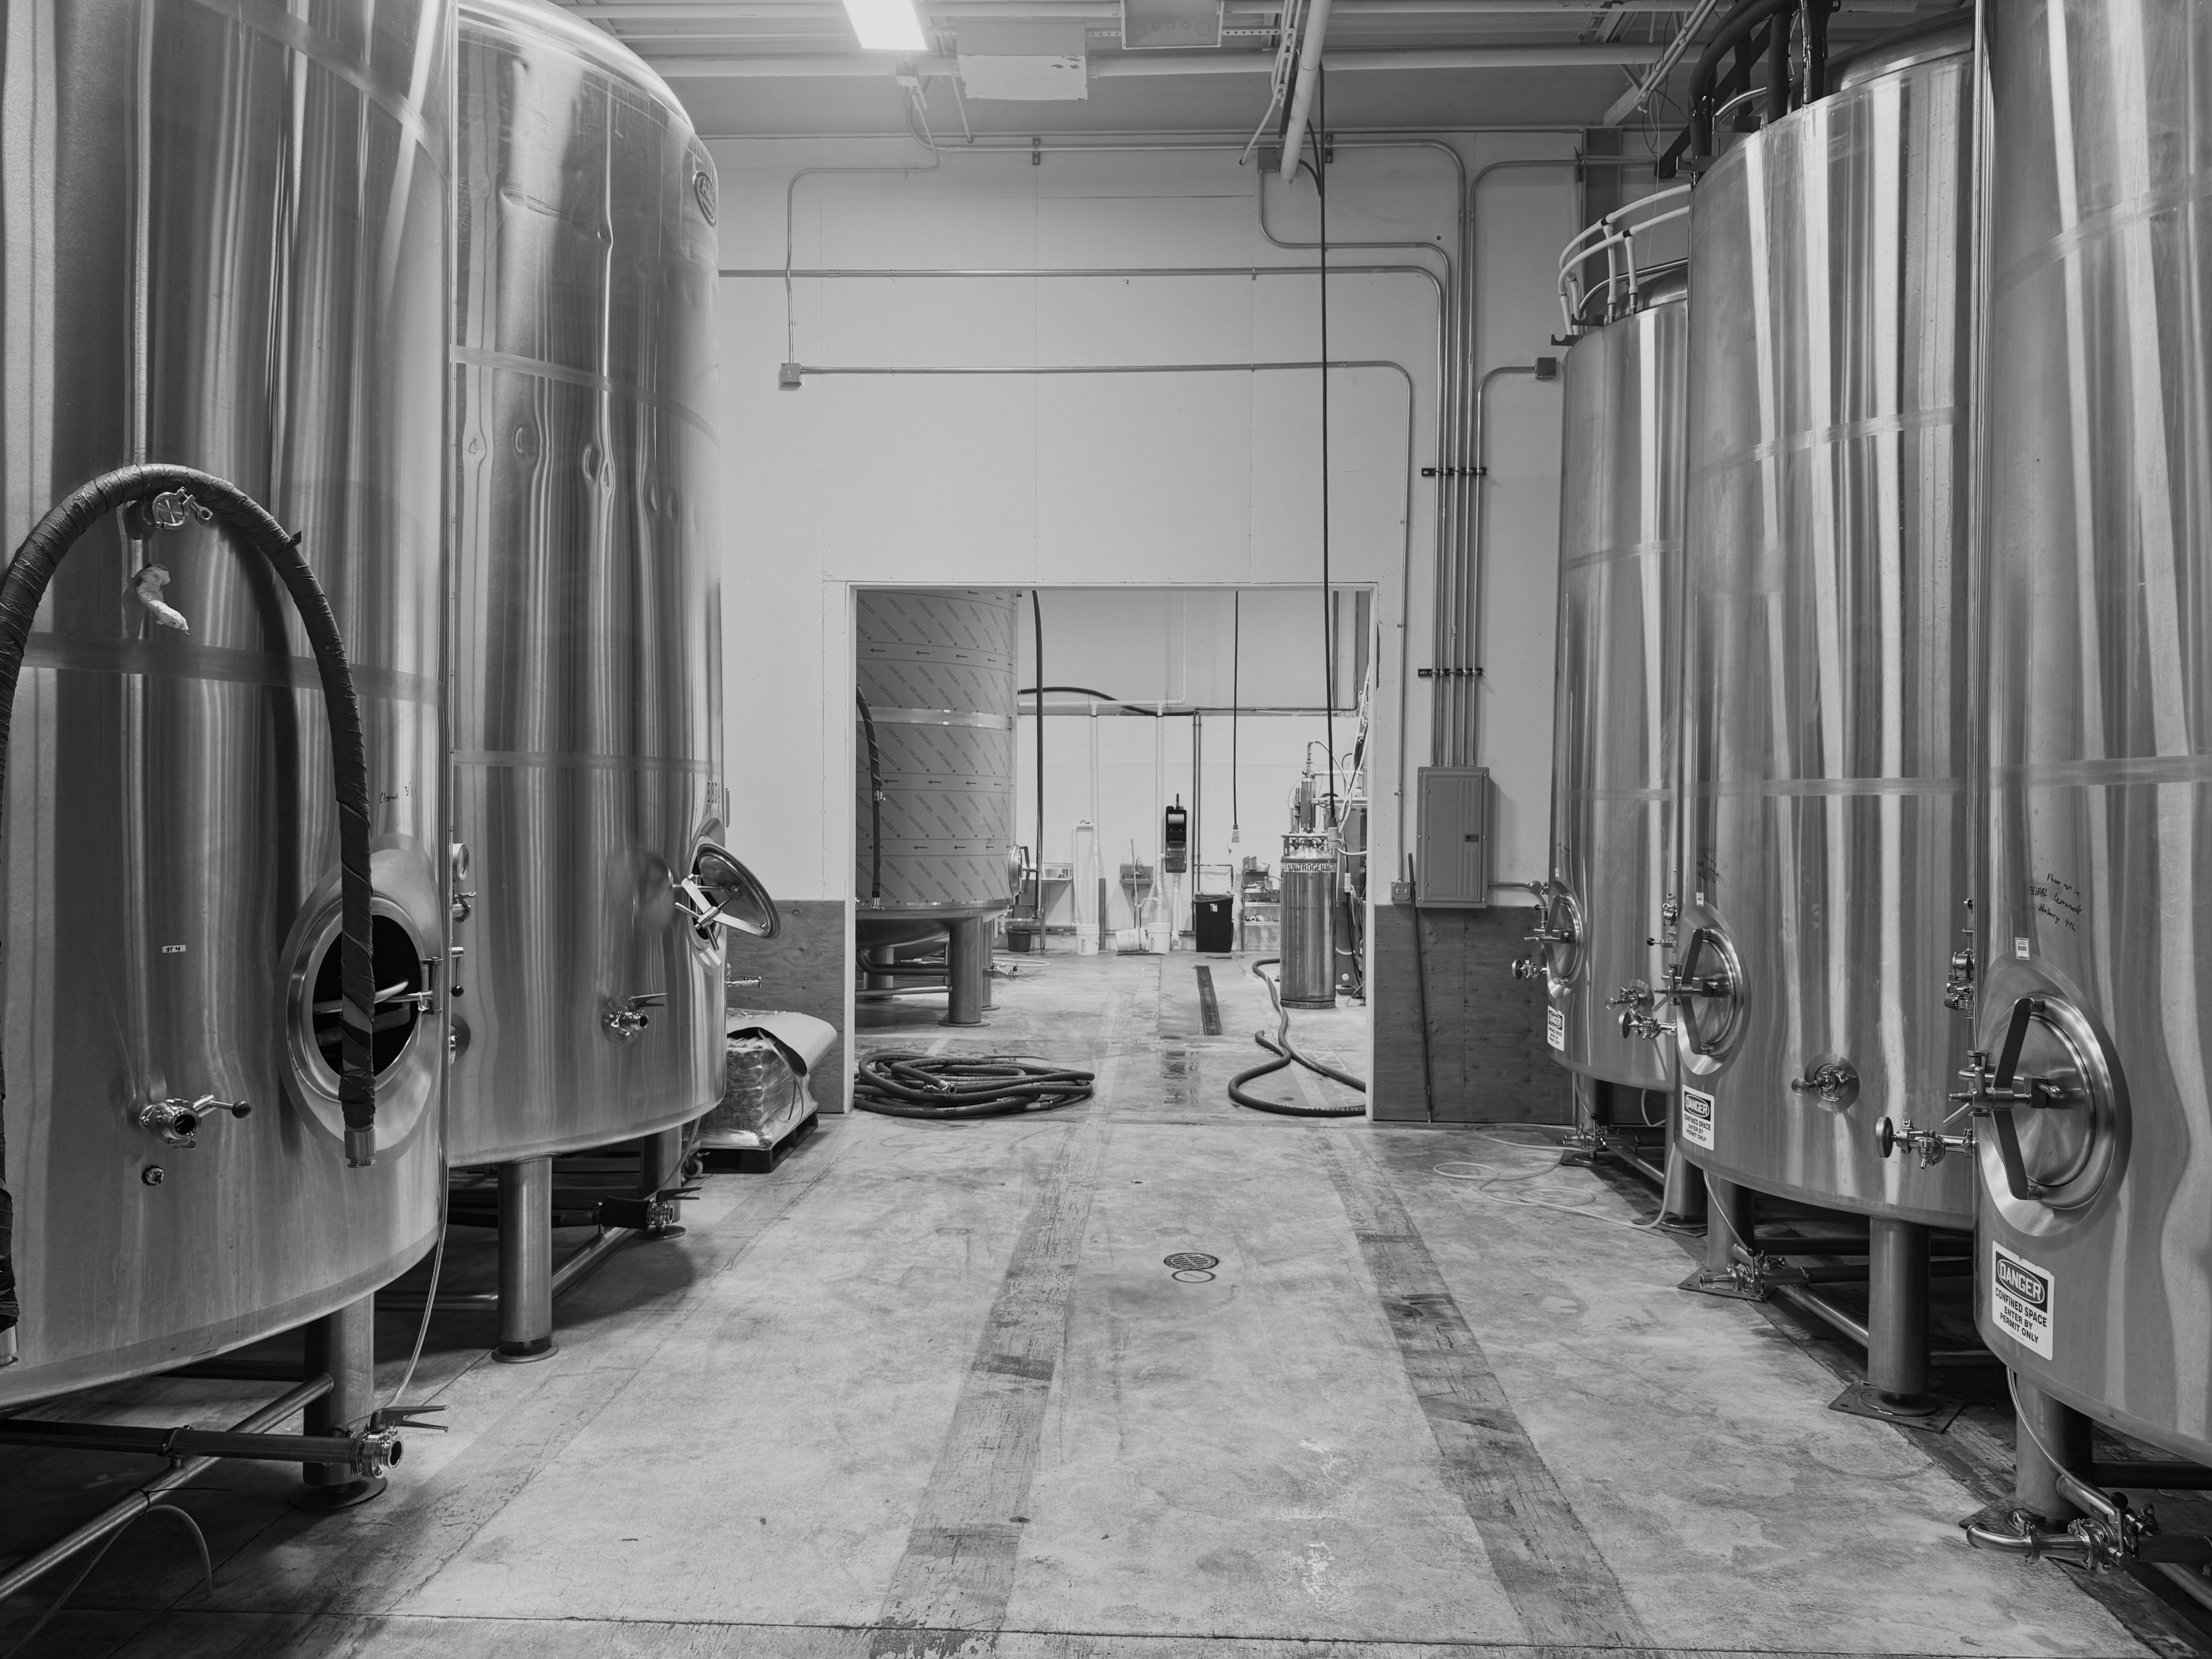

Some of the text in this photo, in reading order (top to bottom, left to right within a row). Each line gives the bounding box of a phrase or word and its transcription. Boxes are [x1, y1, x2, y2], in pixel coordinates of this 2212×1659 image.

[1685, 1097, 1707, 1115] DANGER
[1684, 1114, 1711, 1131] CONFINED SPACE
[1688, 1124, 1698, 1132] ENTER
[1686, 1129, 1696, 1138] PERMIT
[2000, 1262, 2041, 1301] DANGER
[1995, 1287, 2047, 1328] CONFINED SPACE
[2005, 1306, 2033, 1330] ENTER BY
[2000, 1312, 2020, 1332] PERMIT
[2022, 1328, 2039, 1343] ONLY
